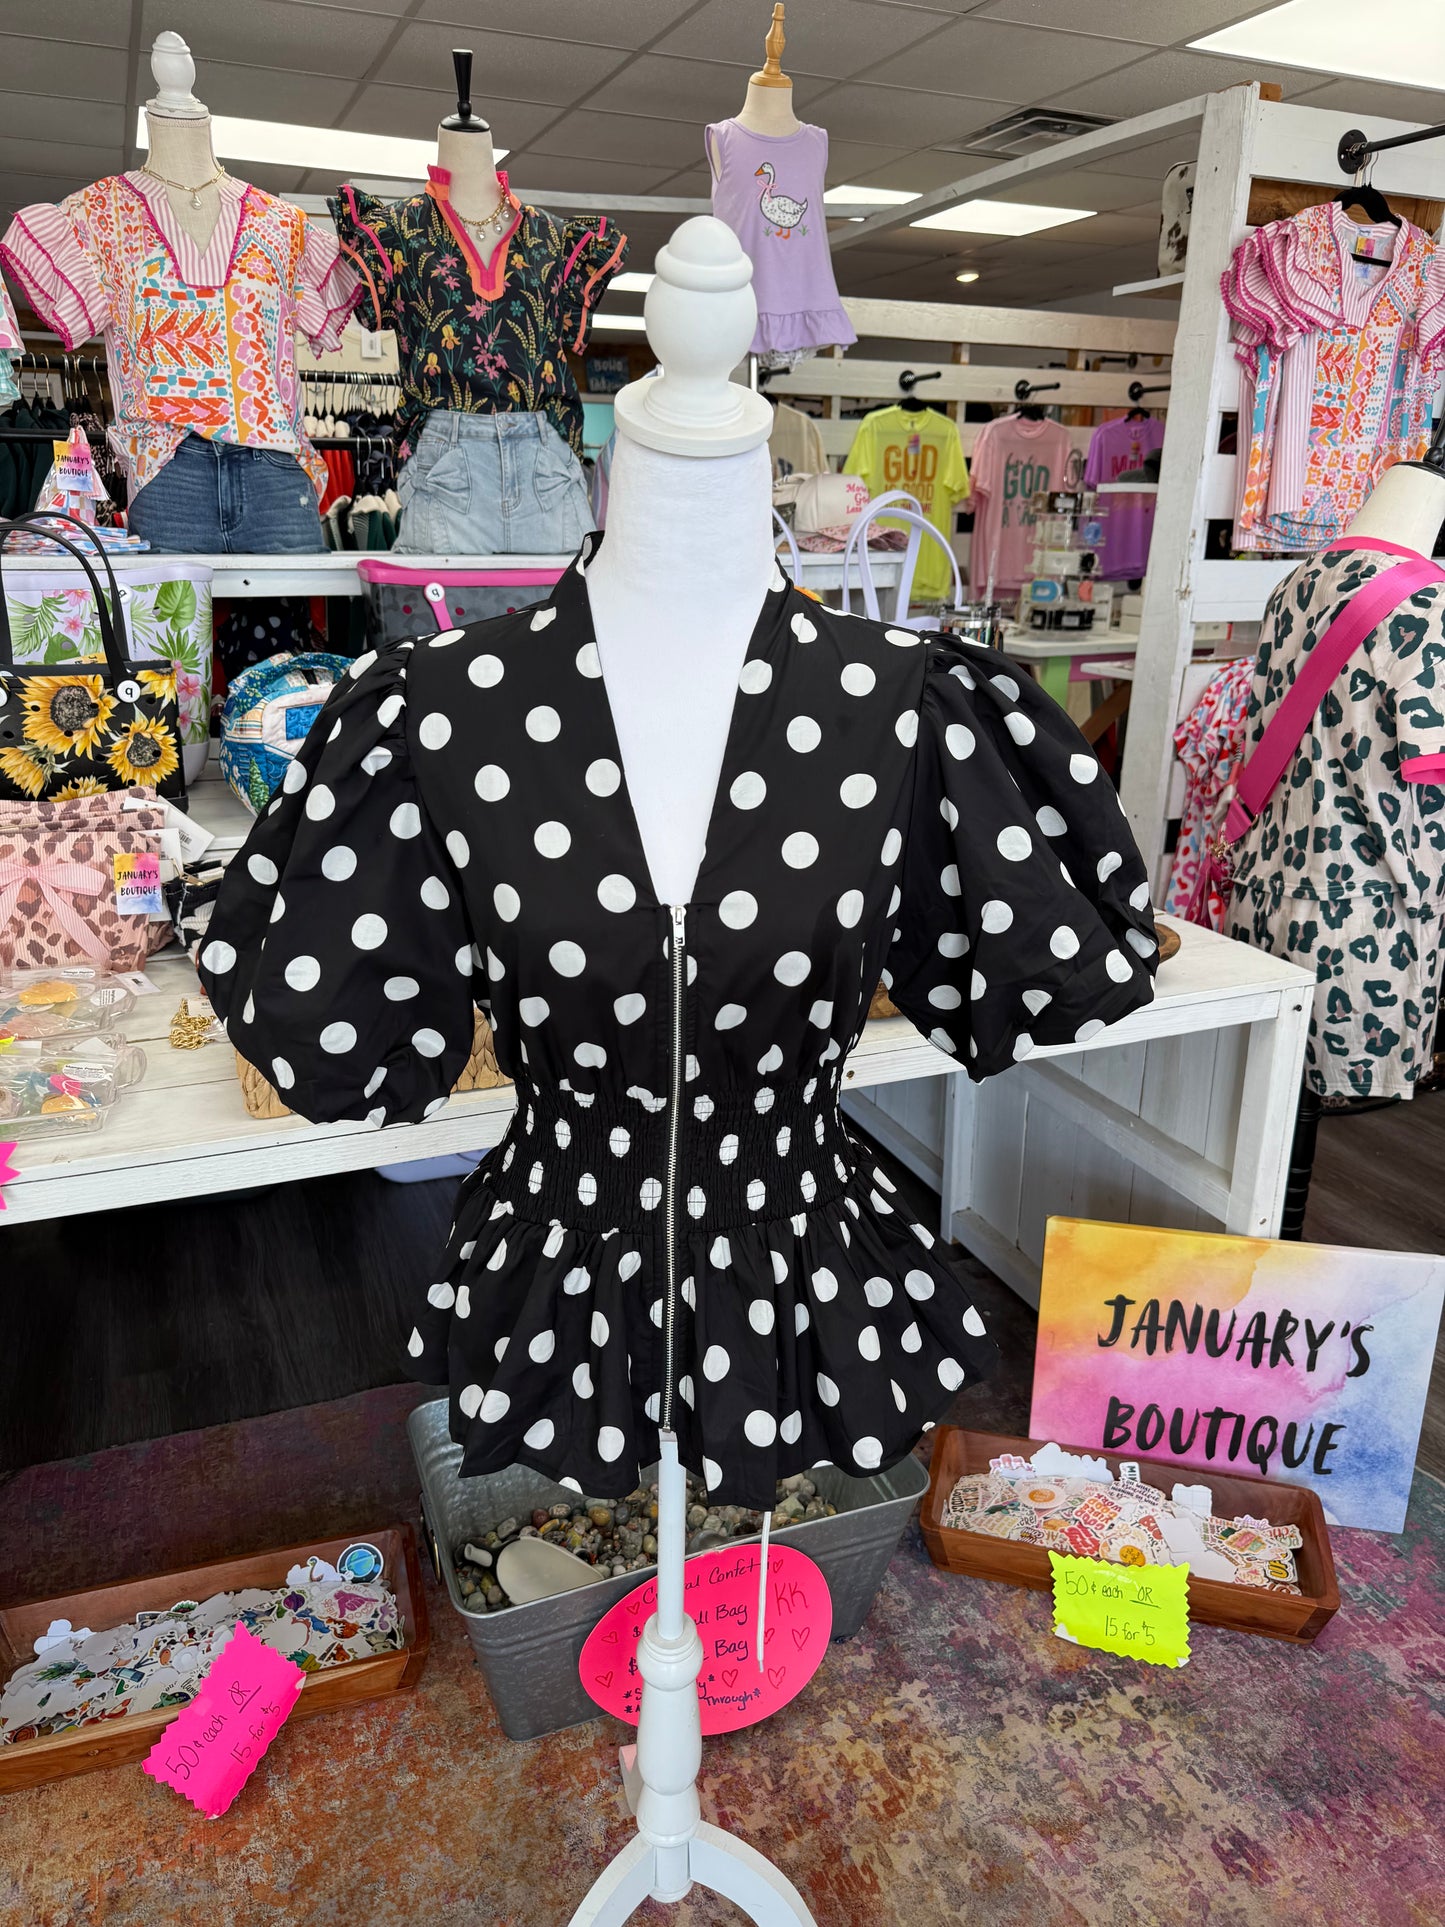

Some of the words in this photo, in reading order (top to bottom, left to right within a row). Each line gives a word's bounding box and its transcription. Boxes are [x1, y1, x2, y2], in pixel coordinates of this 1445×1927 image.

[56, 454, 90, 465] JANUARY'S
[884, 444, 938, 482] GOD
[117, 870, 158, 881] JANUARY'S
[120, 885, 157, 896] BOUTIQUE
[1098, 1294, 1374, 1377] JANUARY'S
[1103, 1396, 1346, 1475] BOUTIQUE
[951, 1488, 964, 1513] LOUDLY
[708, 1555, 771, 1585] Confeti
[774, 1581, 808, 1616] KK
[1101, 1585, 1123, 1599] each
[1137, 1586, 1153, 1604] OR
[716, 1603, 748, 1626] Bag
[1105, 1615, 1118, 1637] 15
[1122, 1622, 1139, 1641] for
[1142, 1621, 1156, 1646] $5
[715, 1639, 749, 1661] Bag
[202, 1714, 228, 1743] each
[228, 1680, 251, 1706] OR
[230, 1742, 252, 1765] 15
[248, 1720, 265, 1741] for
